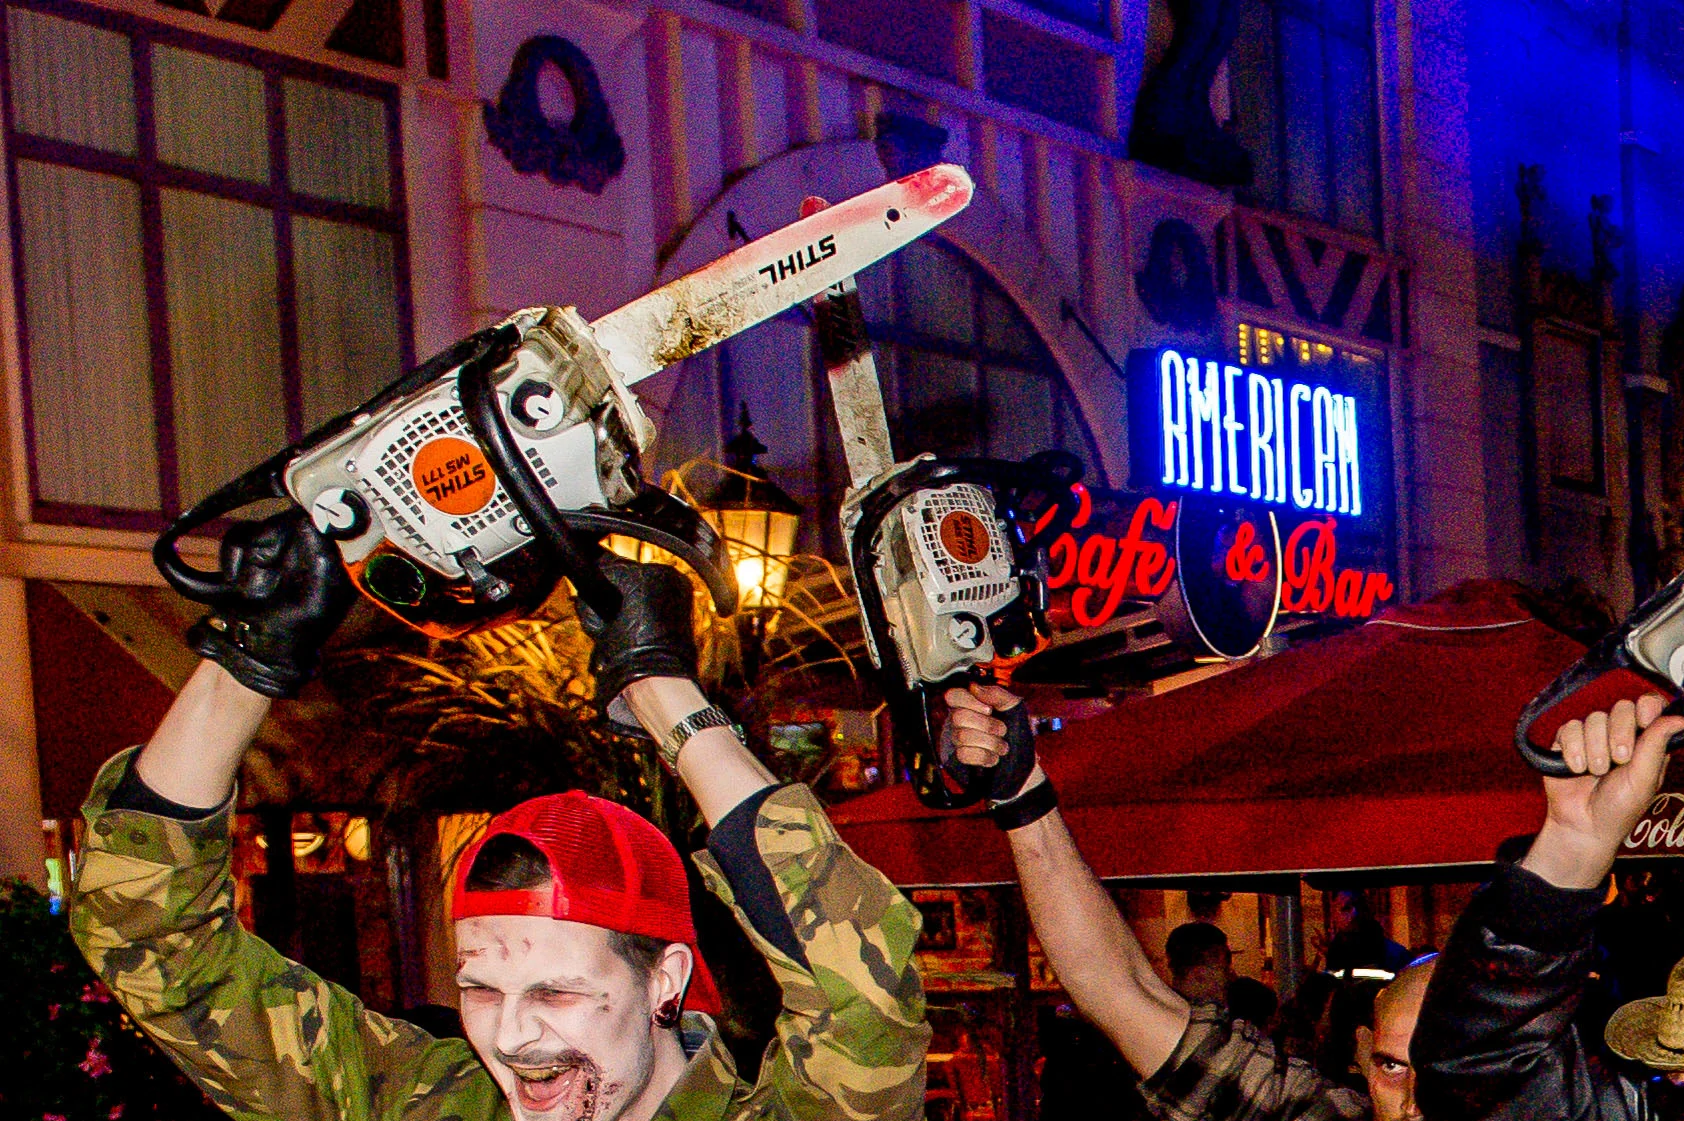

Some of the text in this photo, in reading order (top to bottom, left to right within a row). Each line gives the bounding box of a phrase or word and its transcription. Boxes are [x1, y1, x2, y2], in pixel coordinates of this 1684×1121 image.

[758, 234, 837, 285] STIHL
[1159, 349, 1362, 517] AMERICAN
[425, 462, 486, 501] STIHL
[445, 453, 471, 475] MS
[1225, 521, 1270, 583] &
[1282, 513, 1394, 618] Bar
